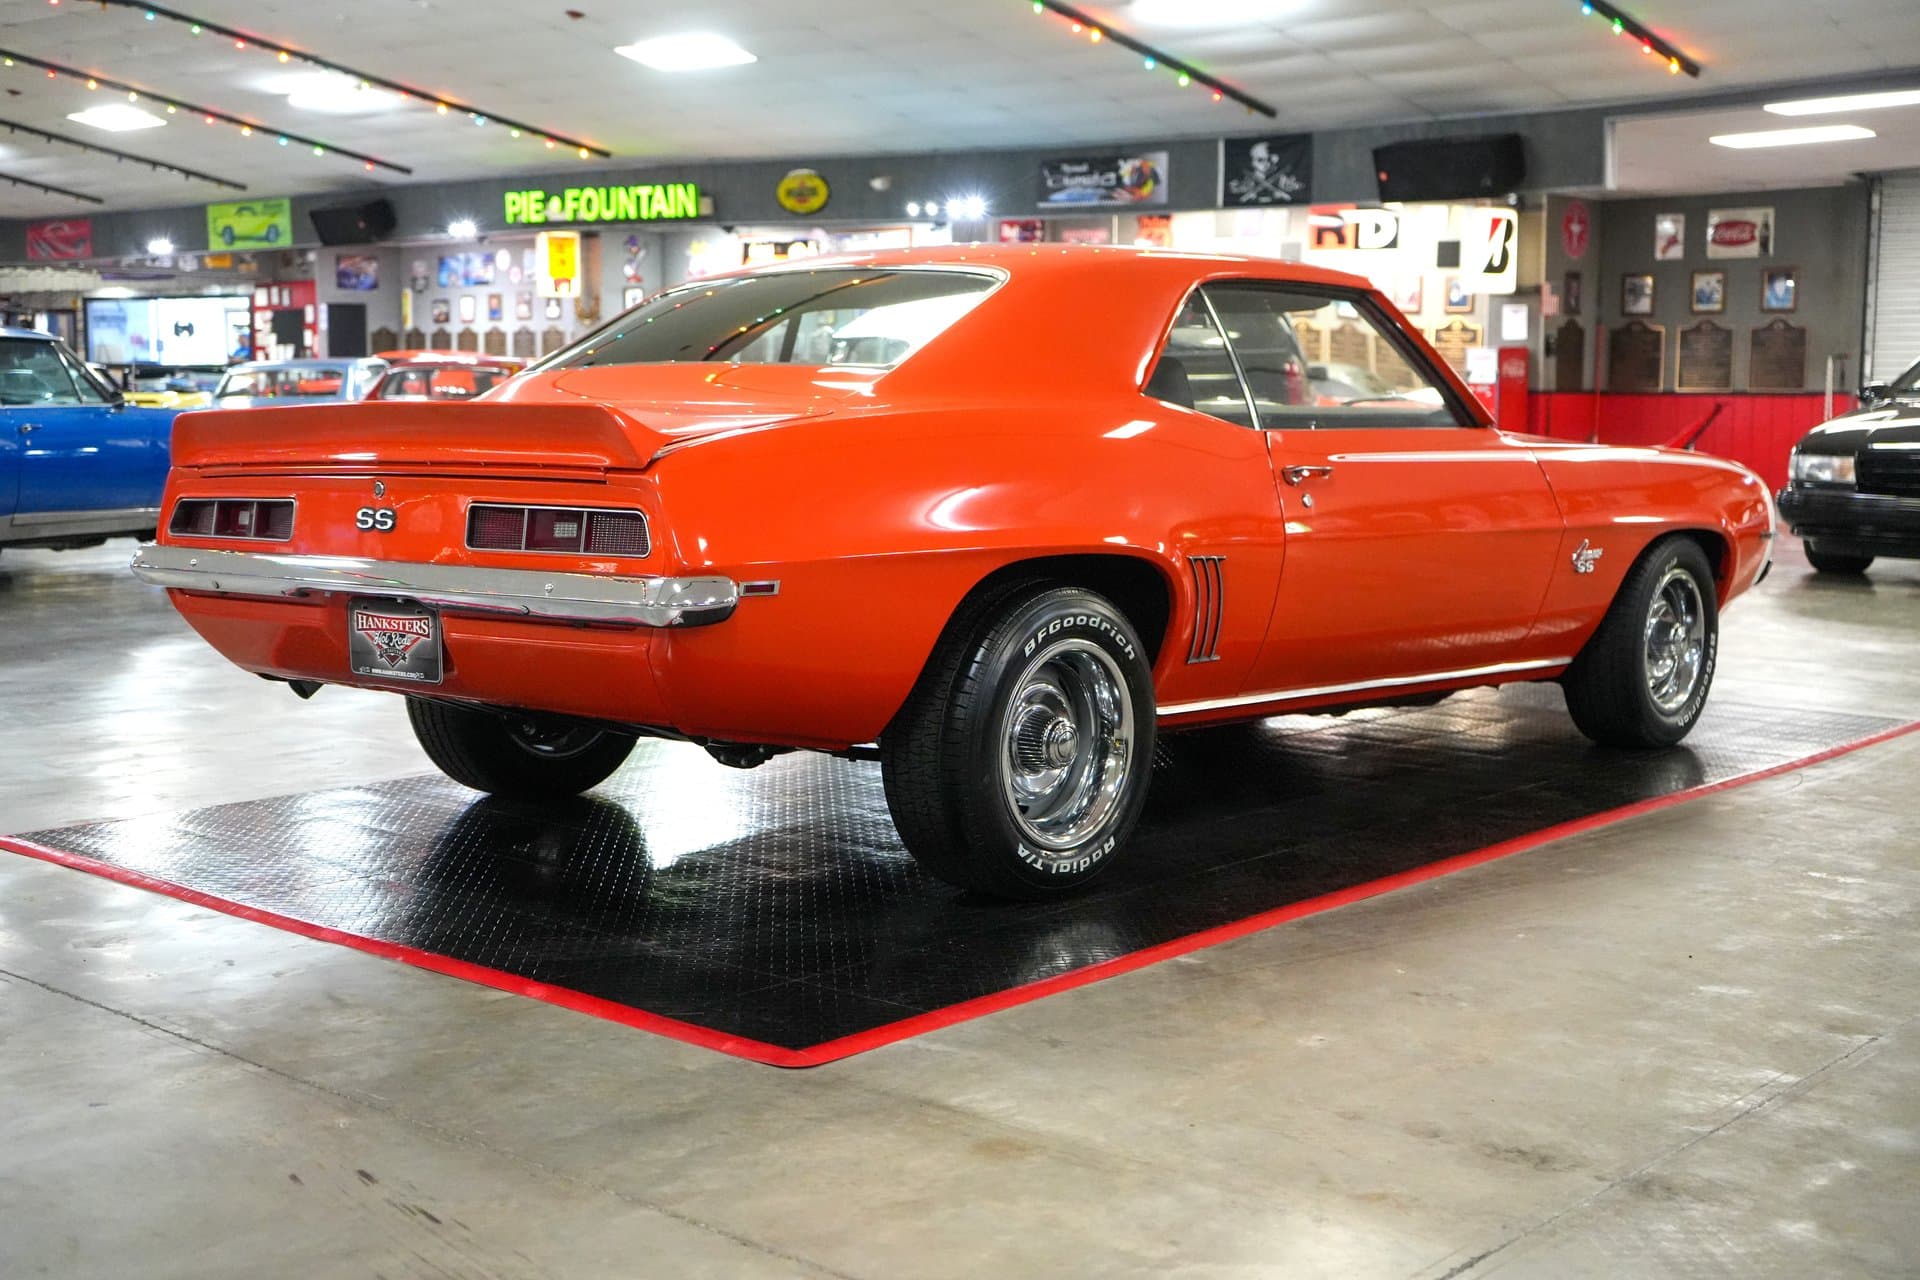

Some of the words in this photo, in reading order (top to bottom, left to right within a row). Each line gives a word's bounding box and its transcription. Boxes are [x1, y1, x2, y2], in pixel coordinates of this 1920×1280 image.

[504, 191, 546, 224] PIE
[563, 183, 698, 223] FOUNTAIN
[355, 507, 395, 531] SS
[1577, 560, 1595, 573] SS
[357, 613, 429, 636] HANKSTERS
[1023, 615, 1137, 661] BFGoodrich
[1016, 841, 1044, 873] T/A
[1050, 834, 1117, 876] Radial
